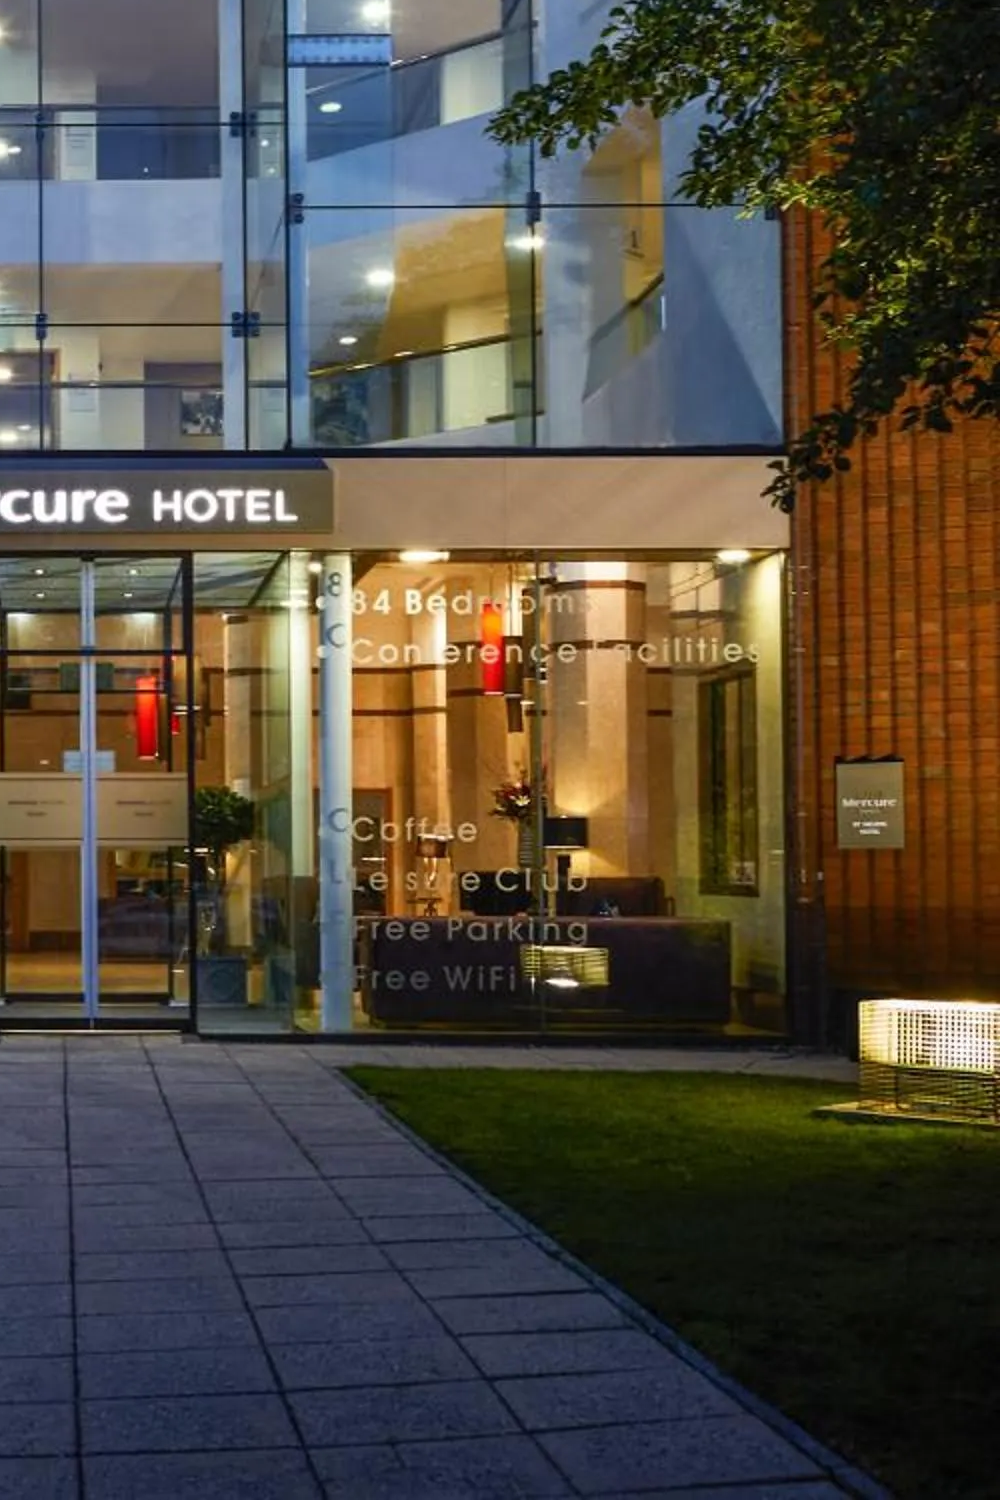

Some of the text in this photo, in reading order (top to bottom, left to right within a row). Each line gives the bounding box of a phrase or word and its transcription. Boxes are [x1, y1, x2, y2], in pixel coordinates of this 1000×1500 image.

[153, 489, 299, 523] HOTEL
[351, 588, 601, 615] 84 Bedrom
[351, 638, 578, 663] Conerence
[352, 816, 478, 842] Coffee
[352, 867, 588, 892] Lesure Club
[352, 916, 589, 945] Free Parking
[352, 965, 517, 991] Free WiFi
